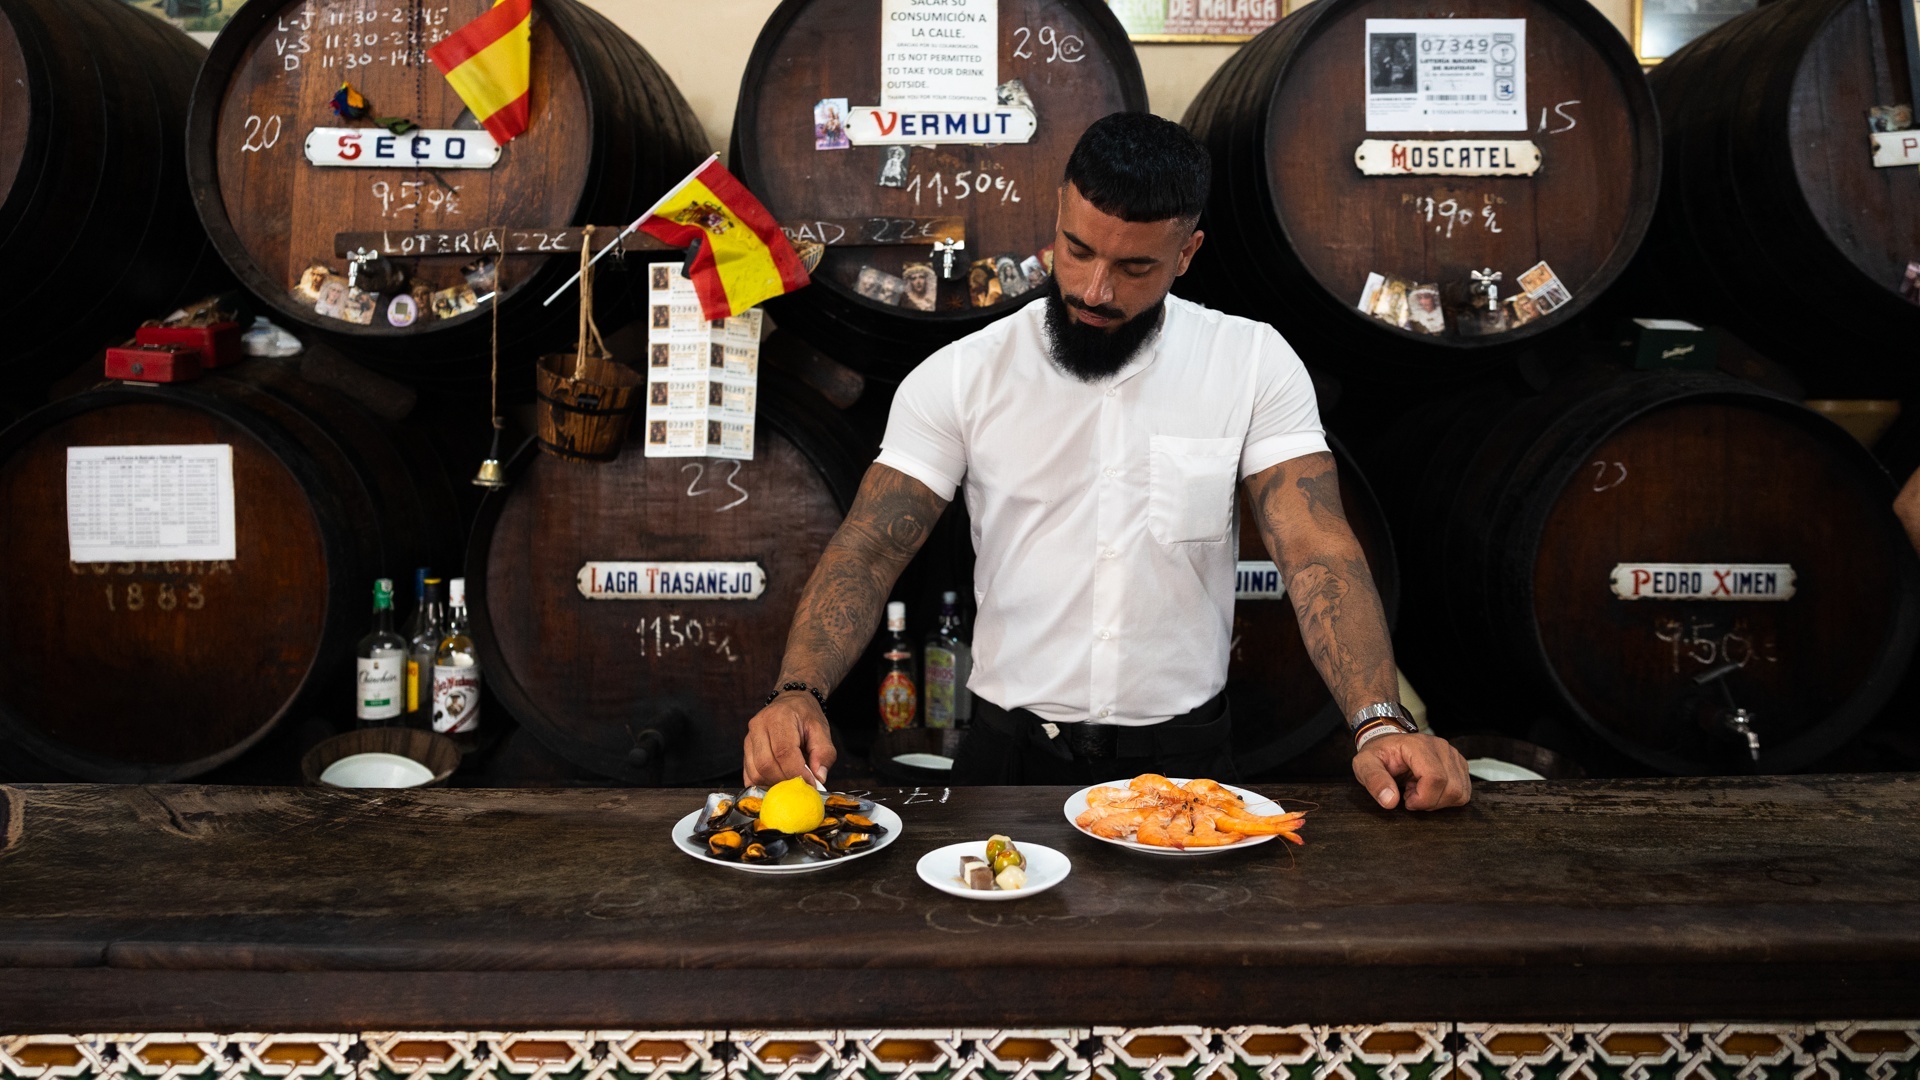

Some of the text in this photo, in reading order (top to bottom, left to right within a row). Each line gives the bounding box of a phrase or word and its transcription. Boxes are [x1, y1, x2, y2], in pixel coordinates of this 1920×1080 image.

[890, 11, 987, 22] CONSUMICIÓN A
[911, 27, 925, 37] LA
[1421, 38, 1489, 52] 07349
[284, 54, 299, 71] D
[887, 53, 983, 63] IT IS NOT PERMITTED
[887, 67, 984, 77] TO TAKE YOUR DRINK
[241, 114, 282, 152] 20
[870, 111, 1012, 136] VERMUT
[337, 134, 466, 160] SECO
[1391, 143, 1516, 171] MOSCATEL
[646, 568, 751, 594] TRASAÑEJO
[1631, 569, 1777, 595] PEDRO XIMEN
